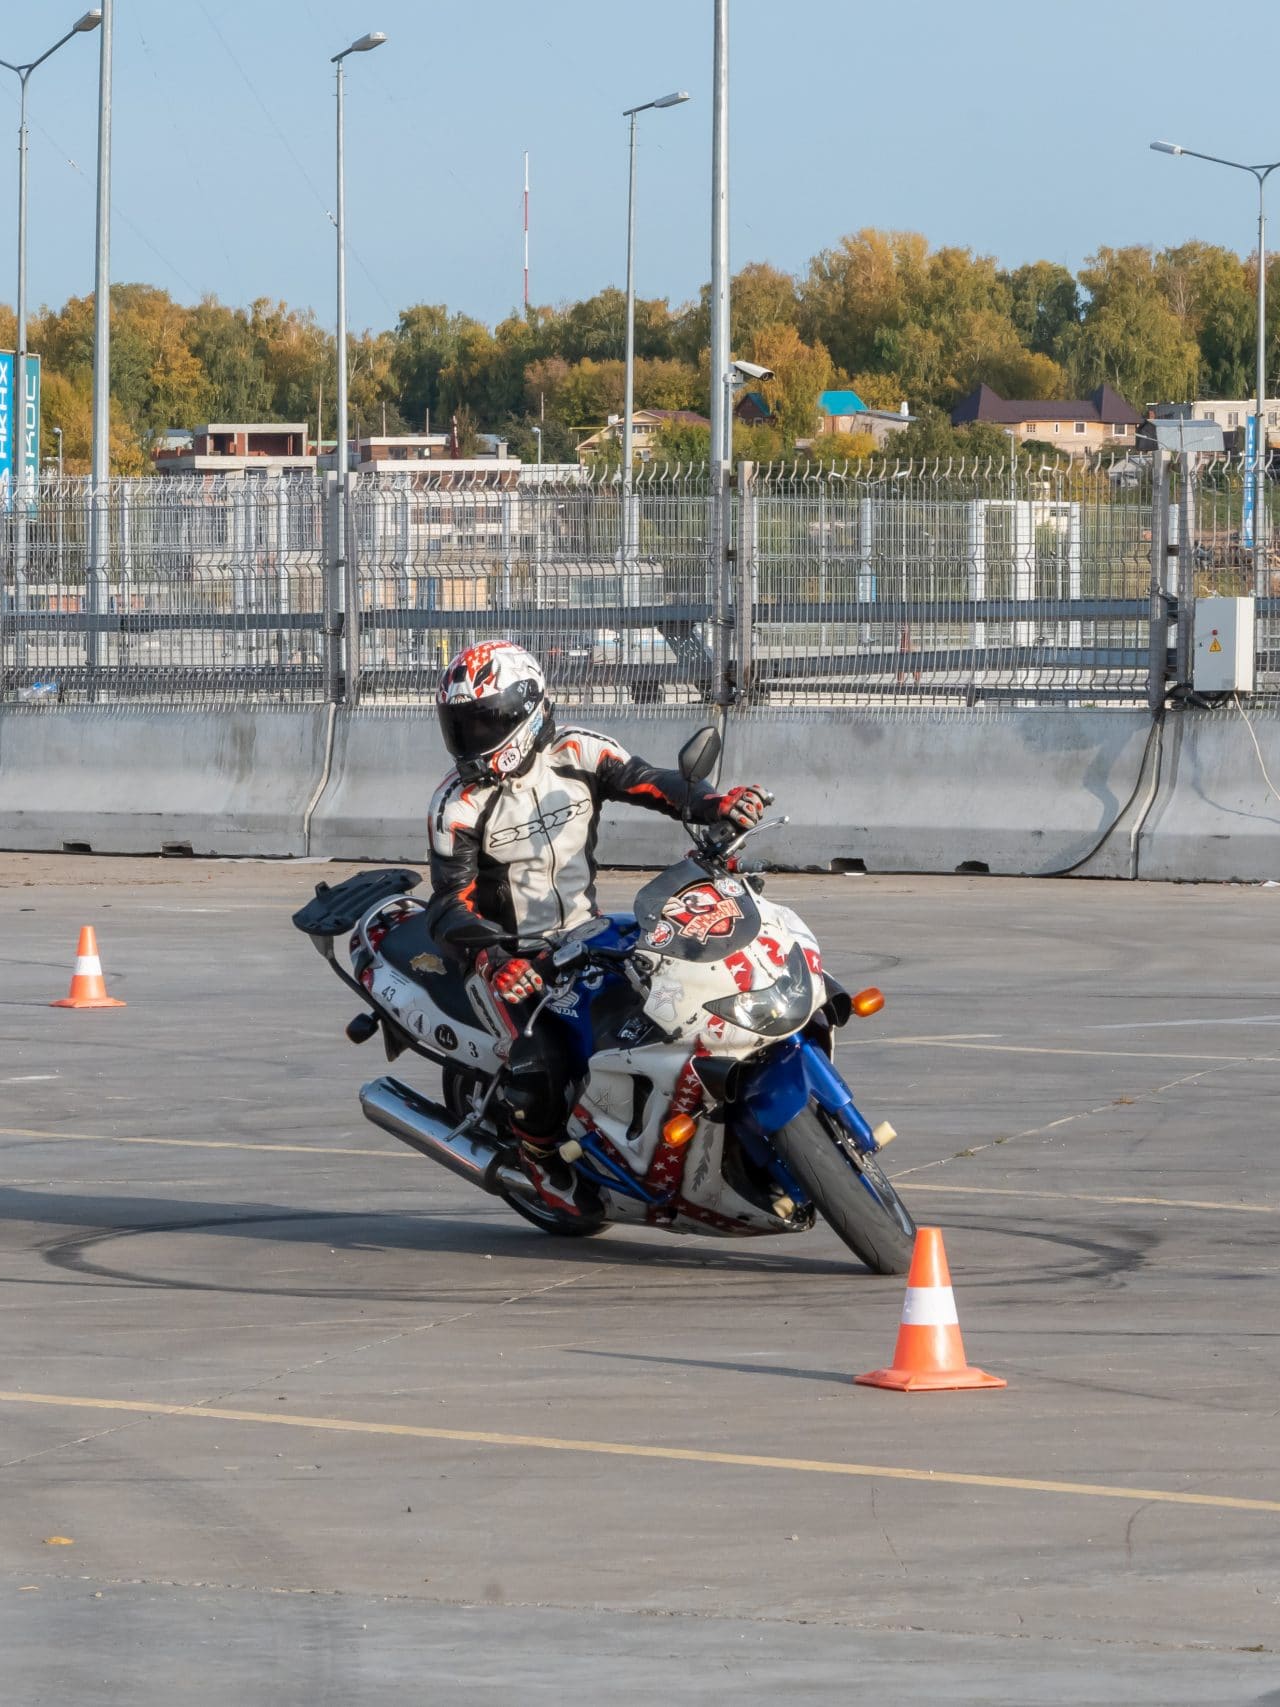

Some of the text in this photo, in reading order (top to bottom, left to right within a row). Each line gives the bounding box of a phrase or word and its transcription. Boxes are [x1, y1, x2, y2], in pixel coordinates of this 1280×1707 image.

[503, 752, 517, 767] 115
[381, 985, 396, 1002] 43
[468, 1041, 479, 1058] 3
